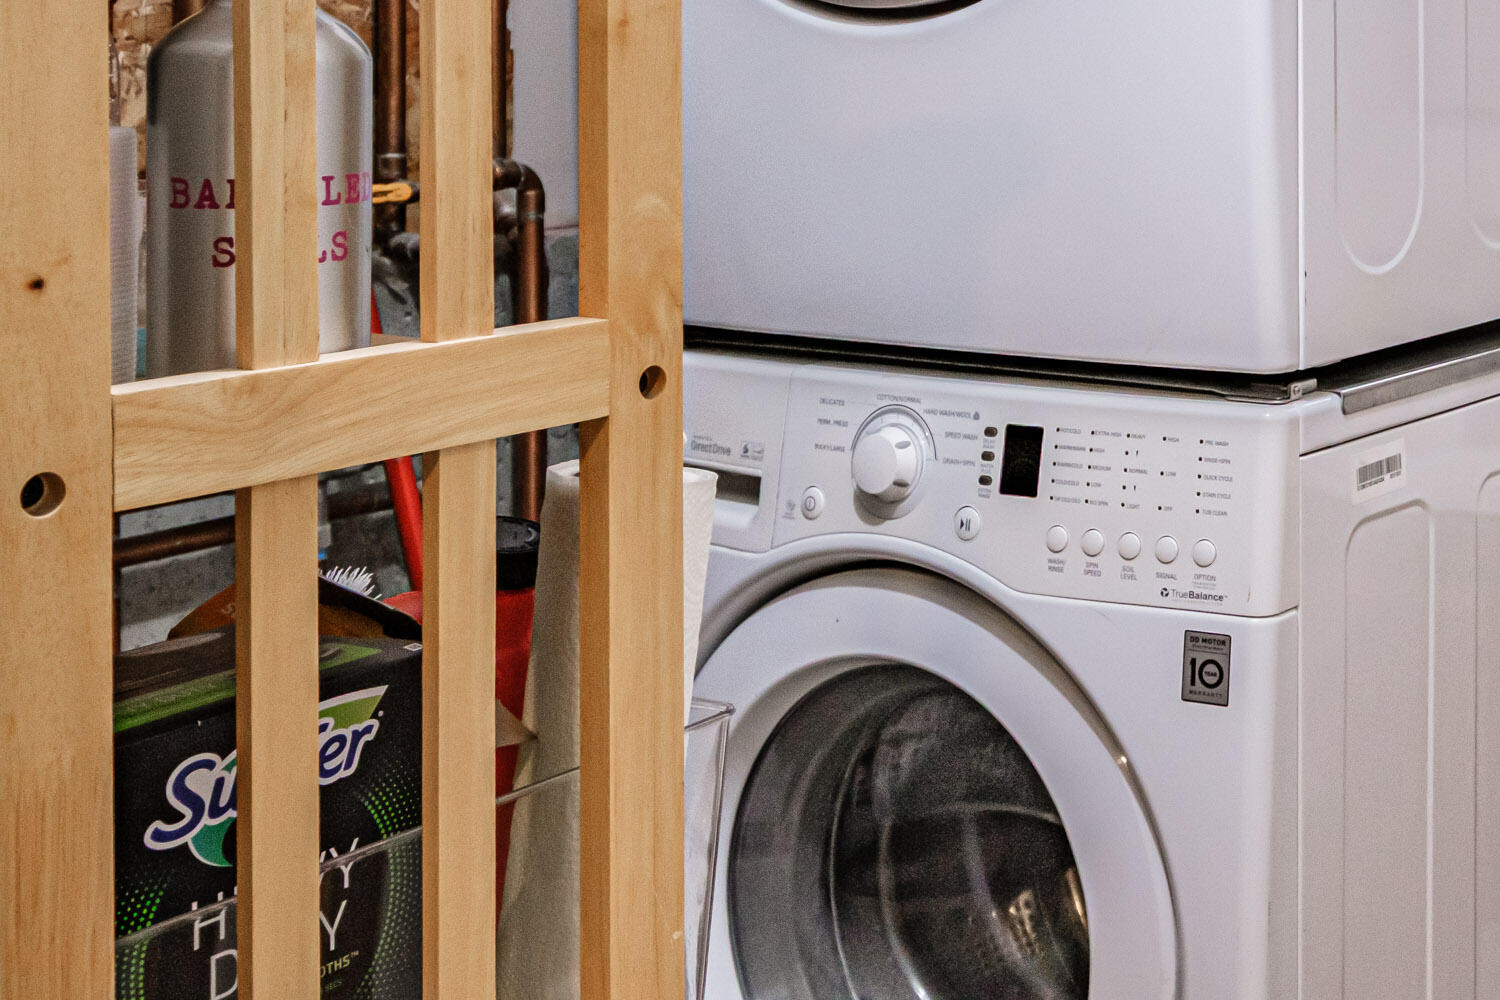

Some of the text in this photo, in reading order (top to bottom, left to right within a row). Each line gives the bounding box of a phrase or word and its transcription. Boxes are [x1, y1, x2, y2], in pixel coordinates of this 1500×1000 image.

[944, 431, 979, 441] SPEED WASH
[1047, 565, 1064, 574] RINSE
[1085, 561, 1099, 569] SPIN
[1121, 565, 1135, 573] SOIL
[1083, 569, 1102, 578] SPEED
[1120, 573, 1138, 581] LEVEL
[1155, 571, 1178, 581] SIGNAL
[1193, 573, 1217, 582] OPTION
[1201, 637, 1226, 647] MOTOR
[1189, 657, 1224, 690] 10
